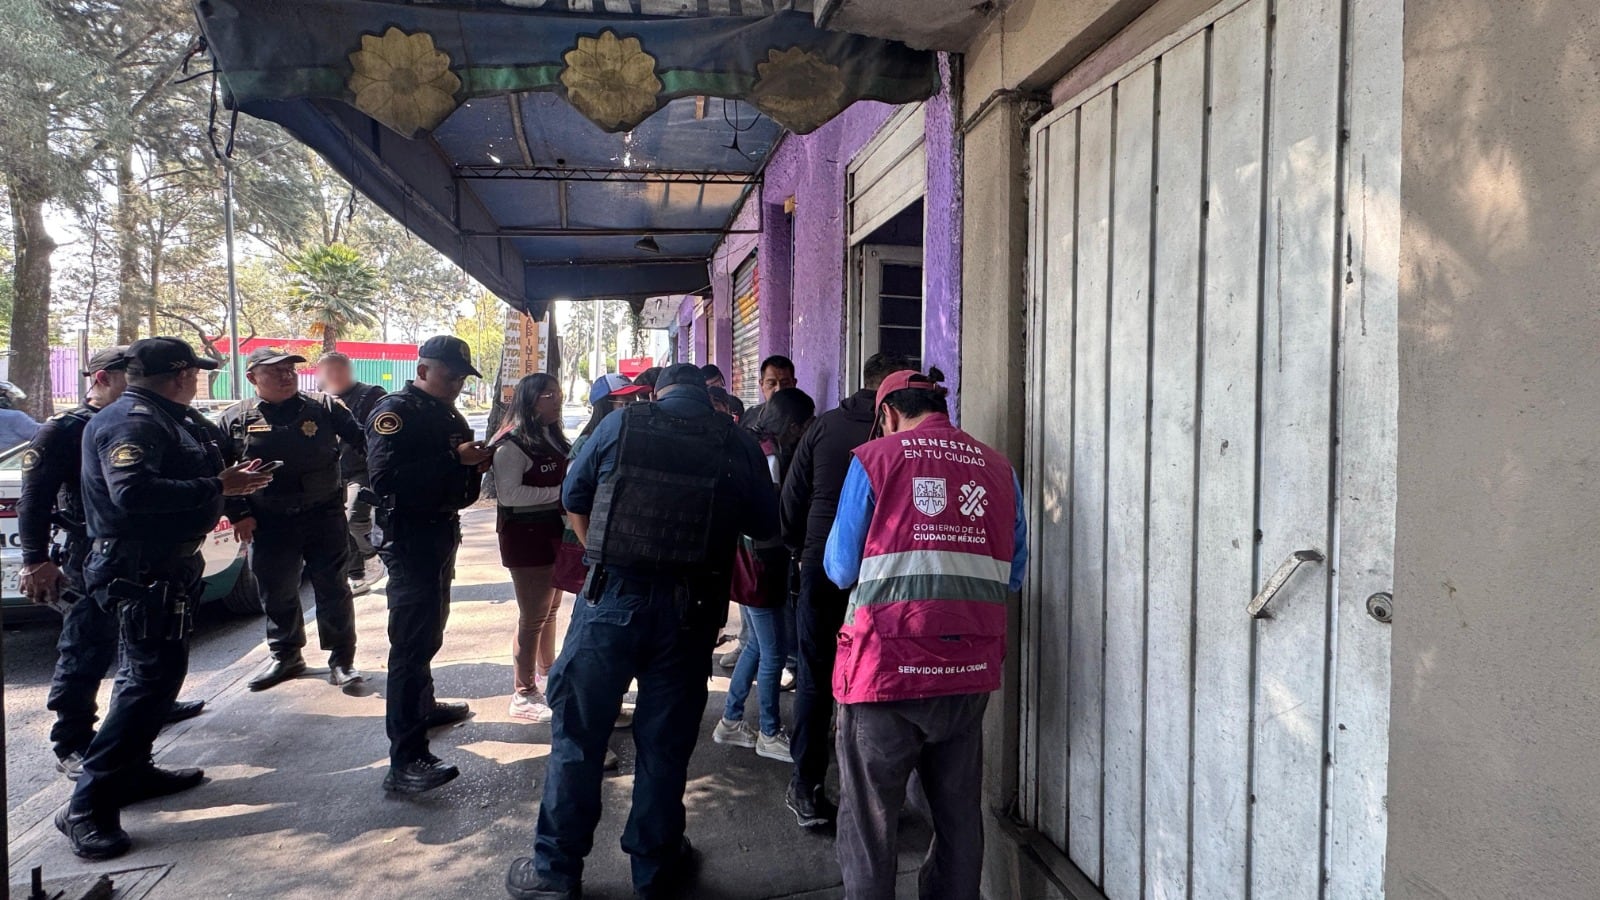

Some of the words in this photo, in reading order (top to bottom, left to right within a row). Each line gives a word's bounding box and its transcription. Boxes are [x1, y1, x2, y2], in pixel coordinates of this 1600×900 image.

[525, 316, 533, 374] ARPINTER
[901, 438, 983, 455] BIENESTAR
[904, 450, 922, 459] EN
[924, 449, 942, 460] TU
[944, 452, 986, 467] CIUDAD
[540, 462, 558, 473] DIF
[913, 523, 960, 533] GOBIERNO
[961, 526, 974, 534] DE
[976, 527, 986, 535] LA
[913, 533, 947, 541] CIUDAD
[947, 534, 957, 542] DE
[957, 533, 986, 544] MÉXICO
[898, 665, 943, 675] SERVIDOR
[945, 666, 955, 674] DE
